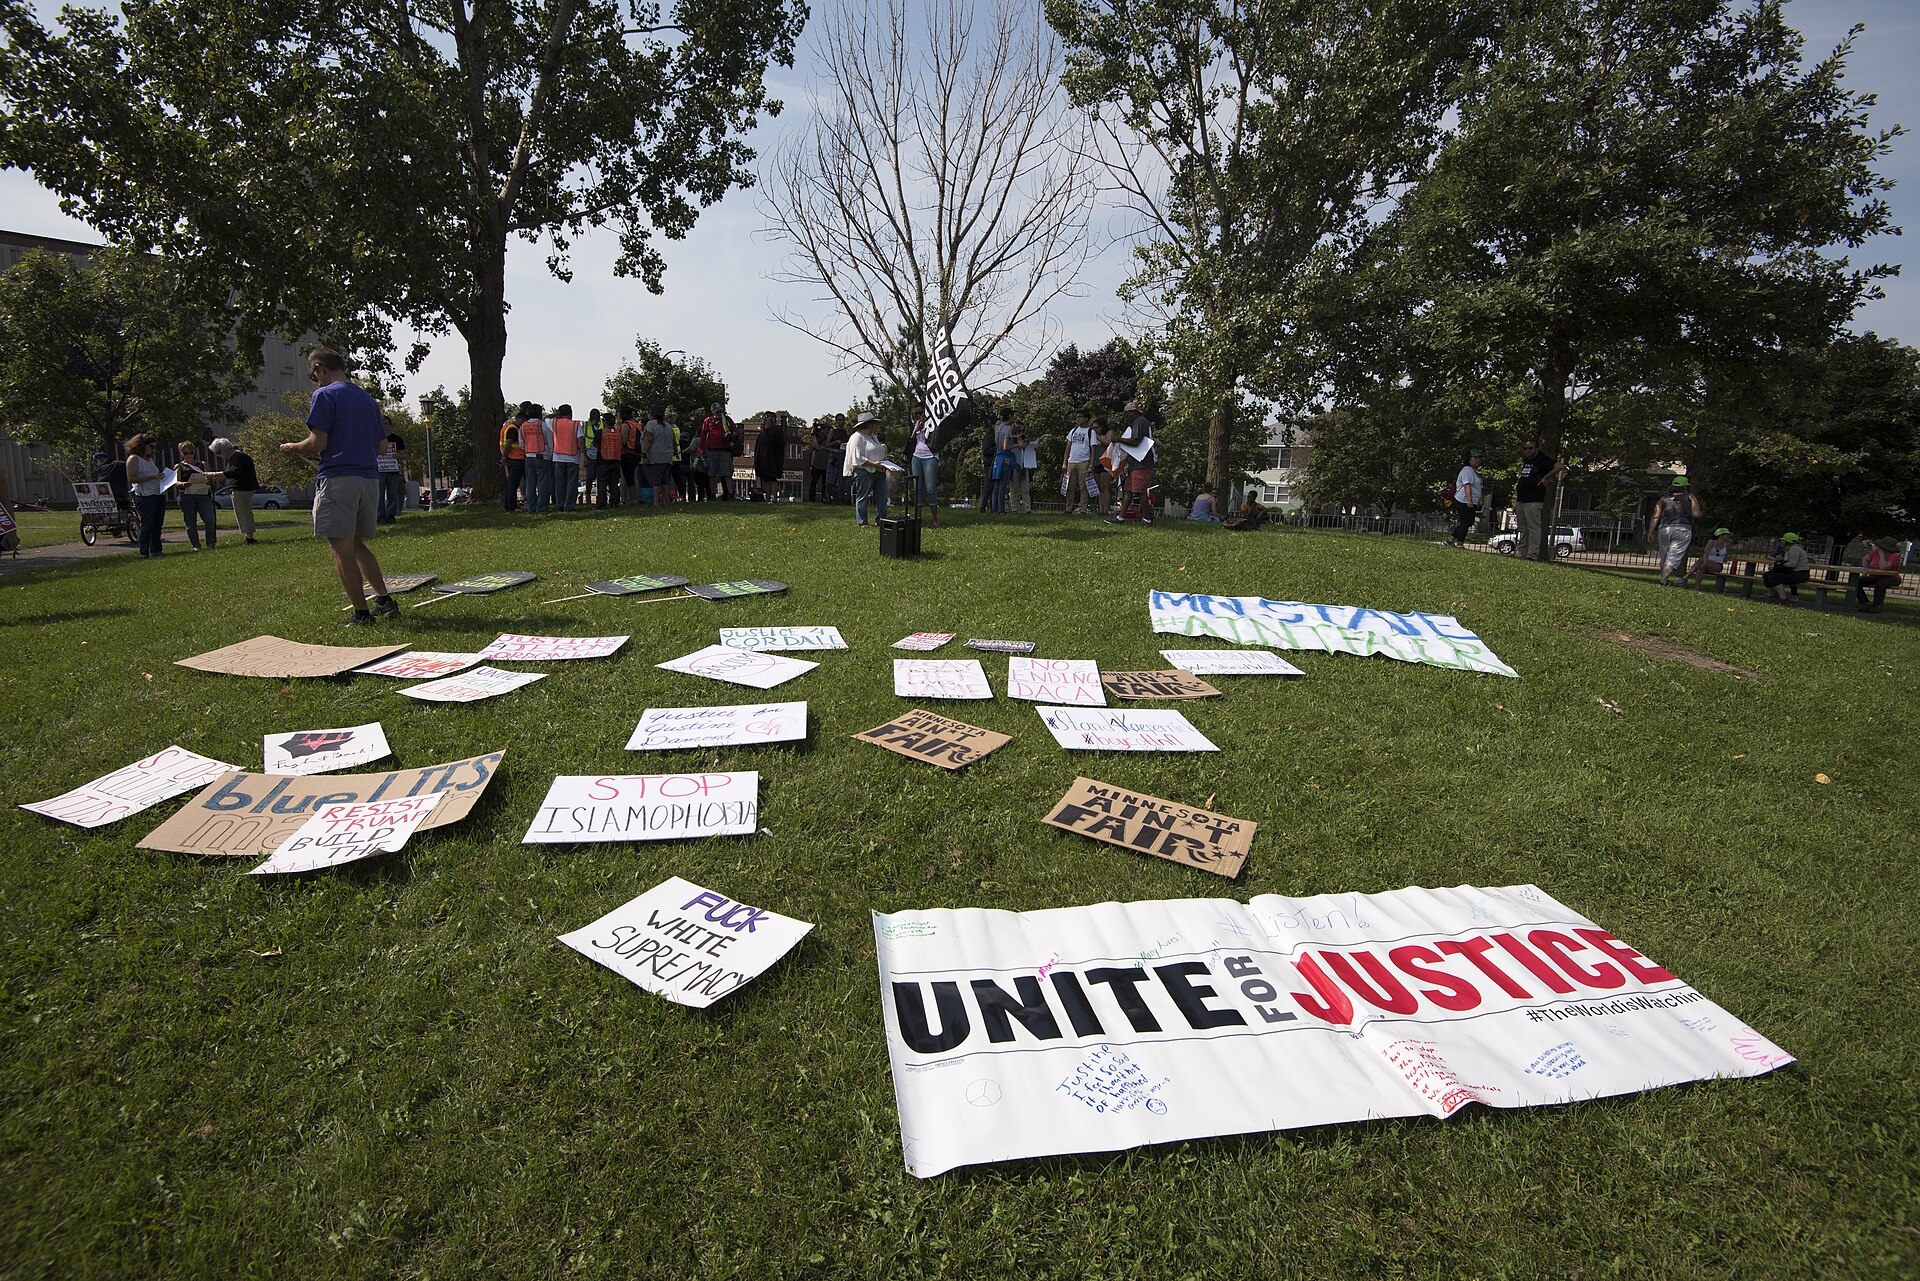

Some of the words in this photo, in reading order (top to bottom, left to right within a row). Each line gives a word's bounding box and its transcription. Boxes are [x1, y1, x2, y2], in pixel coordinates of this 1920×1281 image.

[935, 326, 968, 409] BLACK
[1154, 591, 1245, 616] MN
[723, 628, 799, 638] JUSTICE
[1012, 669, 1099, 684] ENDING
[1031, 659, 1070, 671] NO
[1017, 683, 1097, 701] DACA
[1104, 681, 1204, 696] FAIR
[912, 710, 987, 737] MINNESOTA
[863, 723, 972, 764] FAIR
[137, 749, 233, 784] STOP
[203, 774, 358, 814] blue
[588, 774, 732, 800] STOP
[30, 790, 130, 824] KIDS
[321, 796, 435, 820] RESIST
[324, 810, 430, 833] TRUMP
[533, 801, 758, 833] ISLAMOPHOBIA
[1086, 784, 1240, 832] MINNESOTA
[288, 827, 394, 851] BUILD
[328, 840, 393, 859] THE
[1052, 803, 1215, 864] FAIR
[680, 891, 769, 933] FUCK
[647, 909, 737, 958] WHITE
[591, 925, 755, 1000] SUPREMACY
[1290, 928, 1680, 1025] JUSTICE
[1224, 955, 1299, 1024] FOR
[891, 962, 1249, 1054] UNITE
[1525, 991, 1704, 1023] #TheWorldisWatchin
